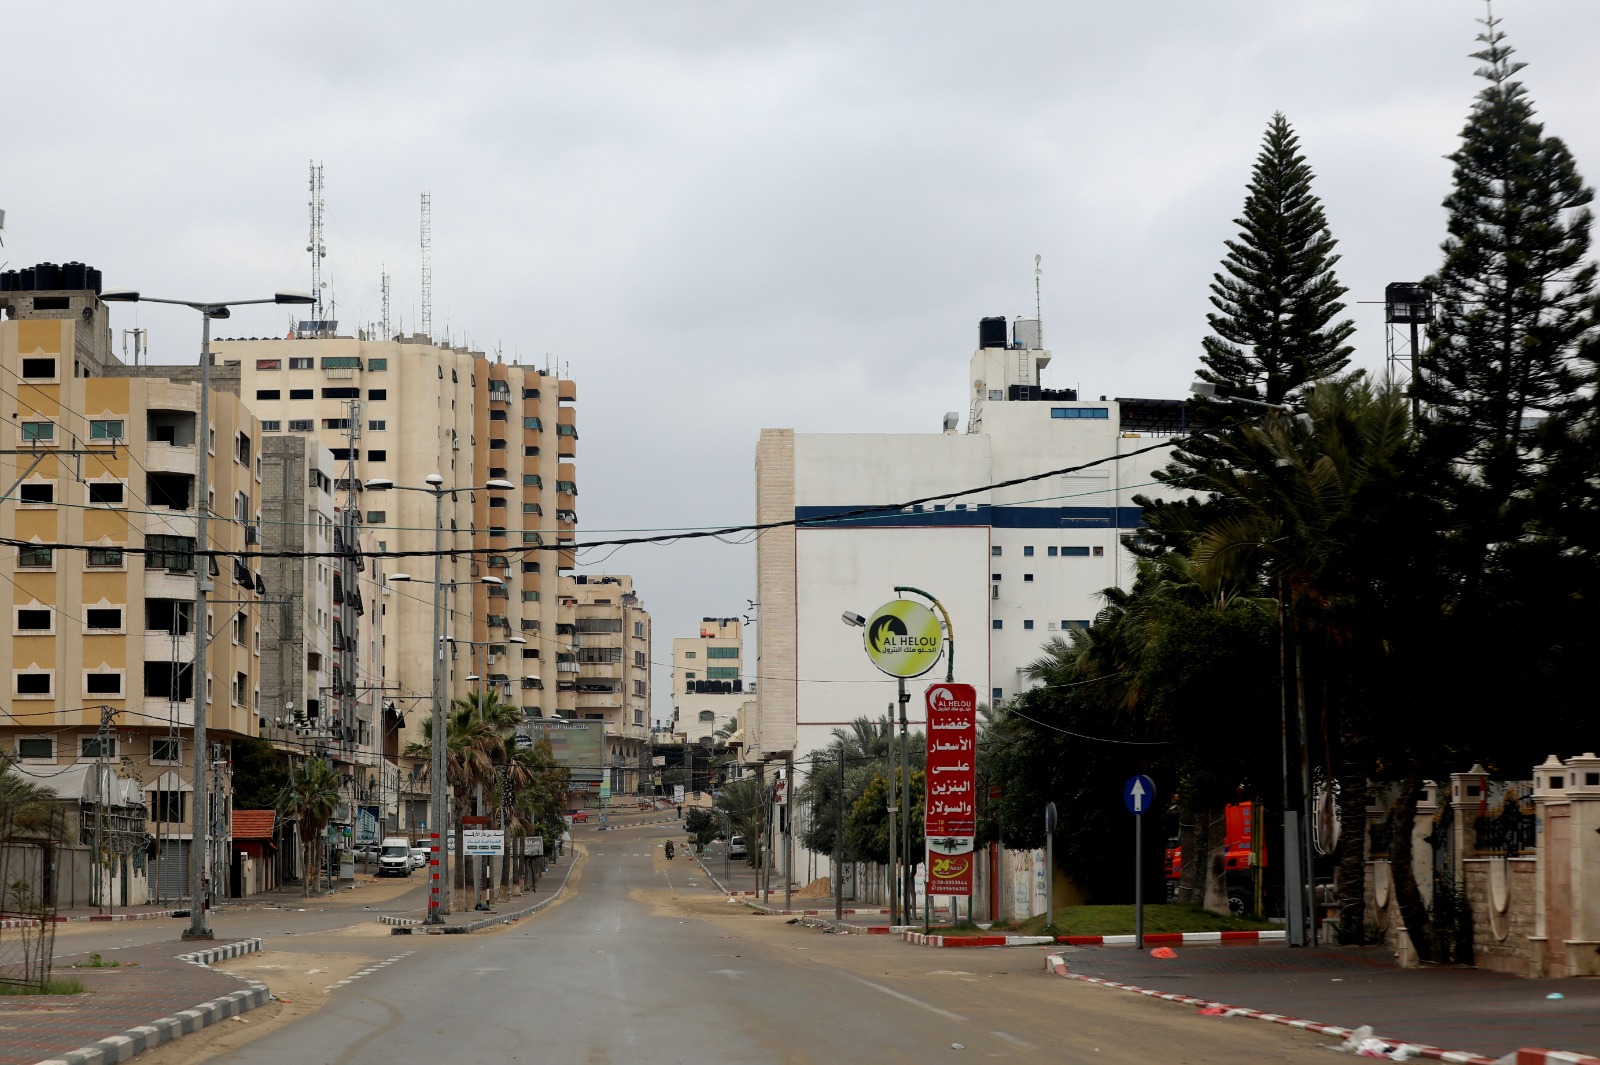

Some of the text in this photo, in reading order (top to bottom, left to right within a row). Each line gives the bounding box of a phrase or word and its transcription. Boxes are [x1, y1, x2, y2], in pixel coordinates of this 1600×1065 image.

[883, 637, 936, 646] AL HELOU
[882, 646, 902, 654] البترول
[918, 646, 936, 654] الحلو
[931, 717, 971, 730] خفضنا
[929, 736, 971, 753] الأسعار
[931, 759, 970, 774] على
[931, 779, 970, 795] البنزين
[929, 800, 971, 815] والسولار
[934, 858, 950, 871] 24
